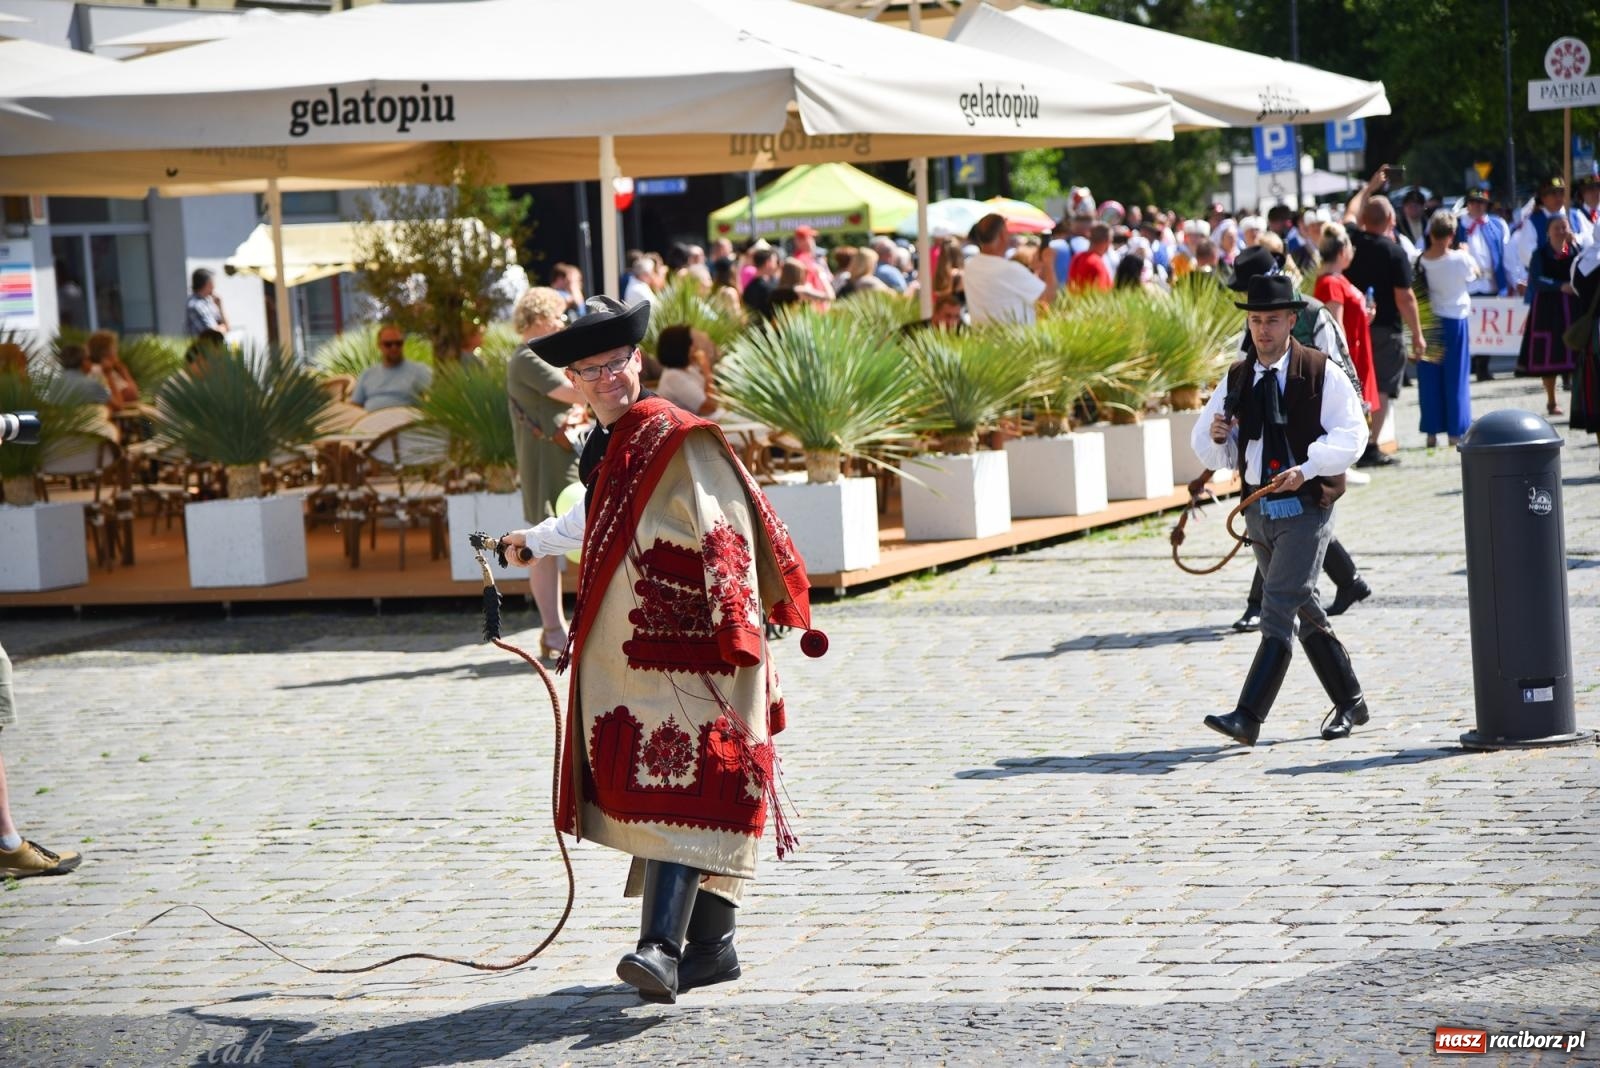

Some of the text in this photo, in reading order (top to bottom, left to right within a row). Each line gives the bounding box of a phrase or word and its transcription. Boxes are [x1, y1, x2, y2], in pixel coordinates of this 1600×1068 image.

[959, 82, 1040, 128] gelatopiu
[1539, 81, 1597, 99] PATRIA
[289, 83, 455, 137] gelatopiu
[1261, 125, 1288, 160] P
[1335, 120, 1357, 148] P
